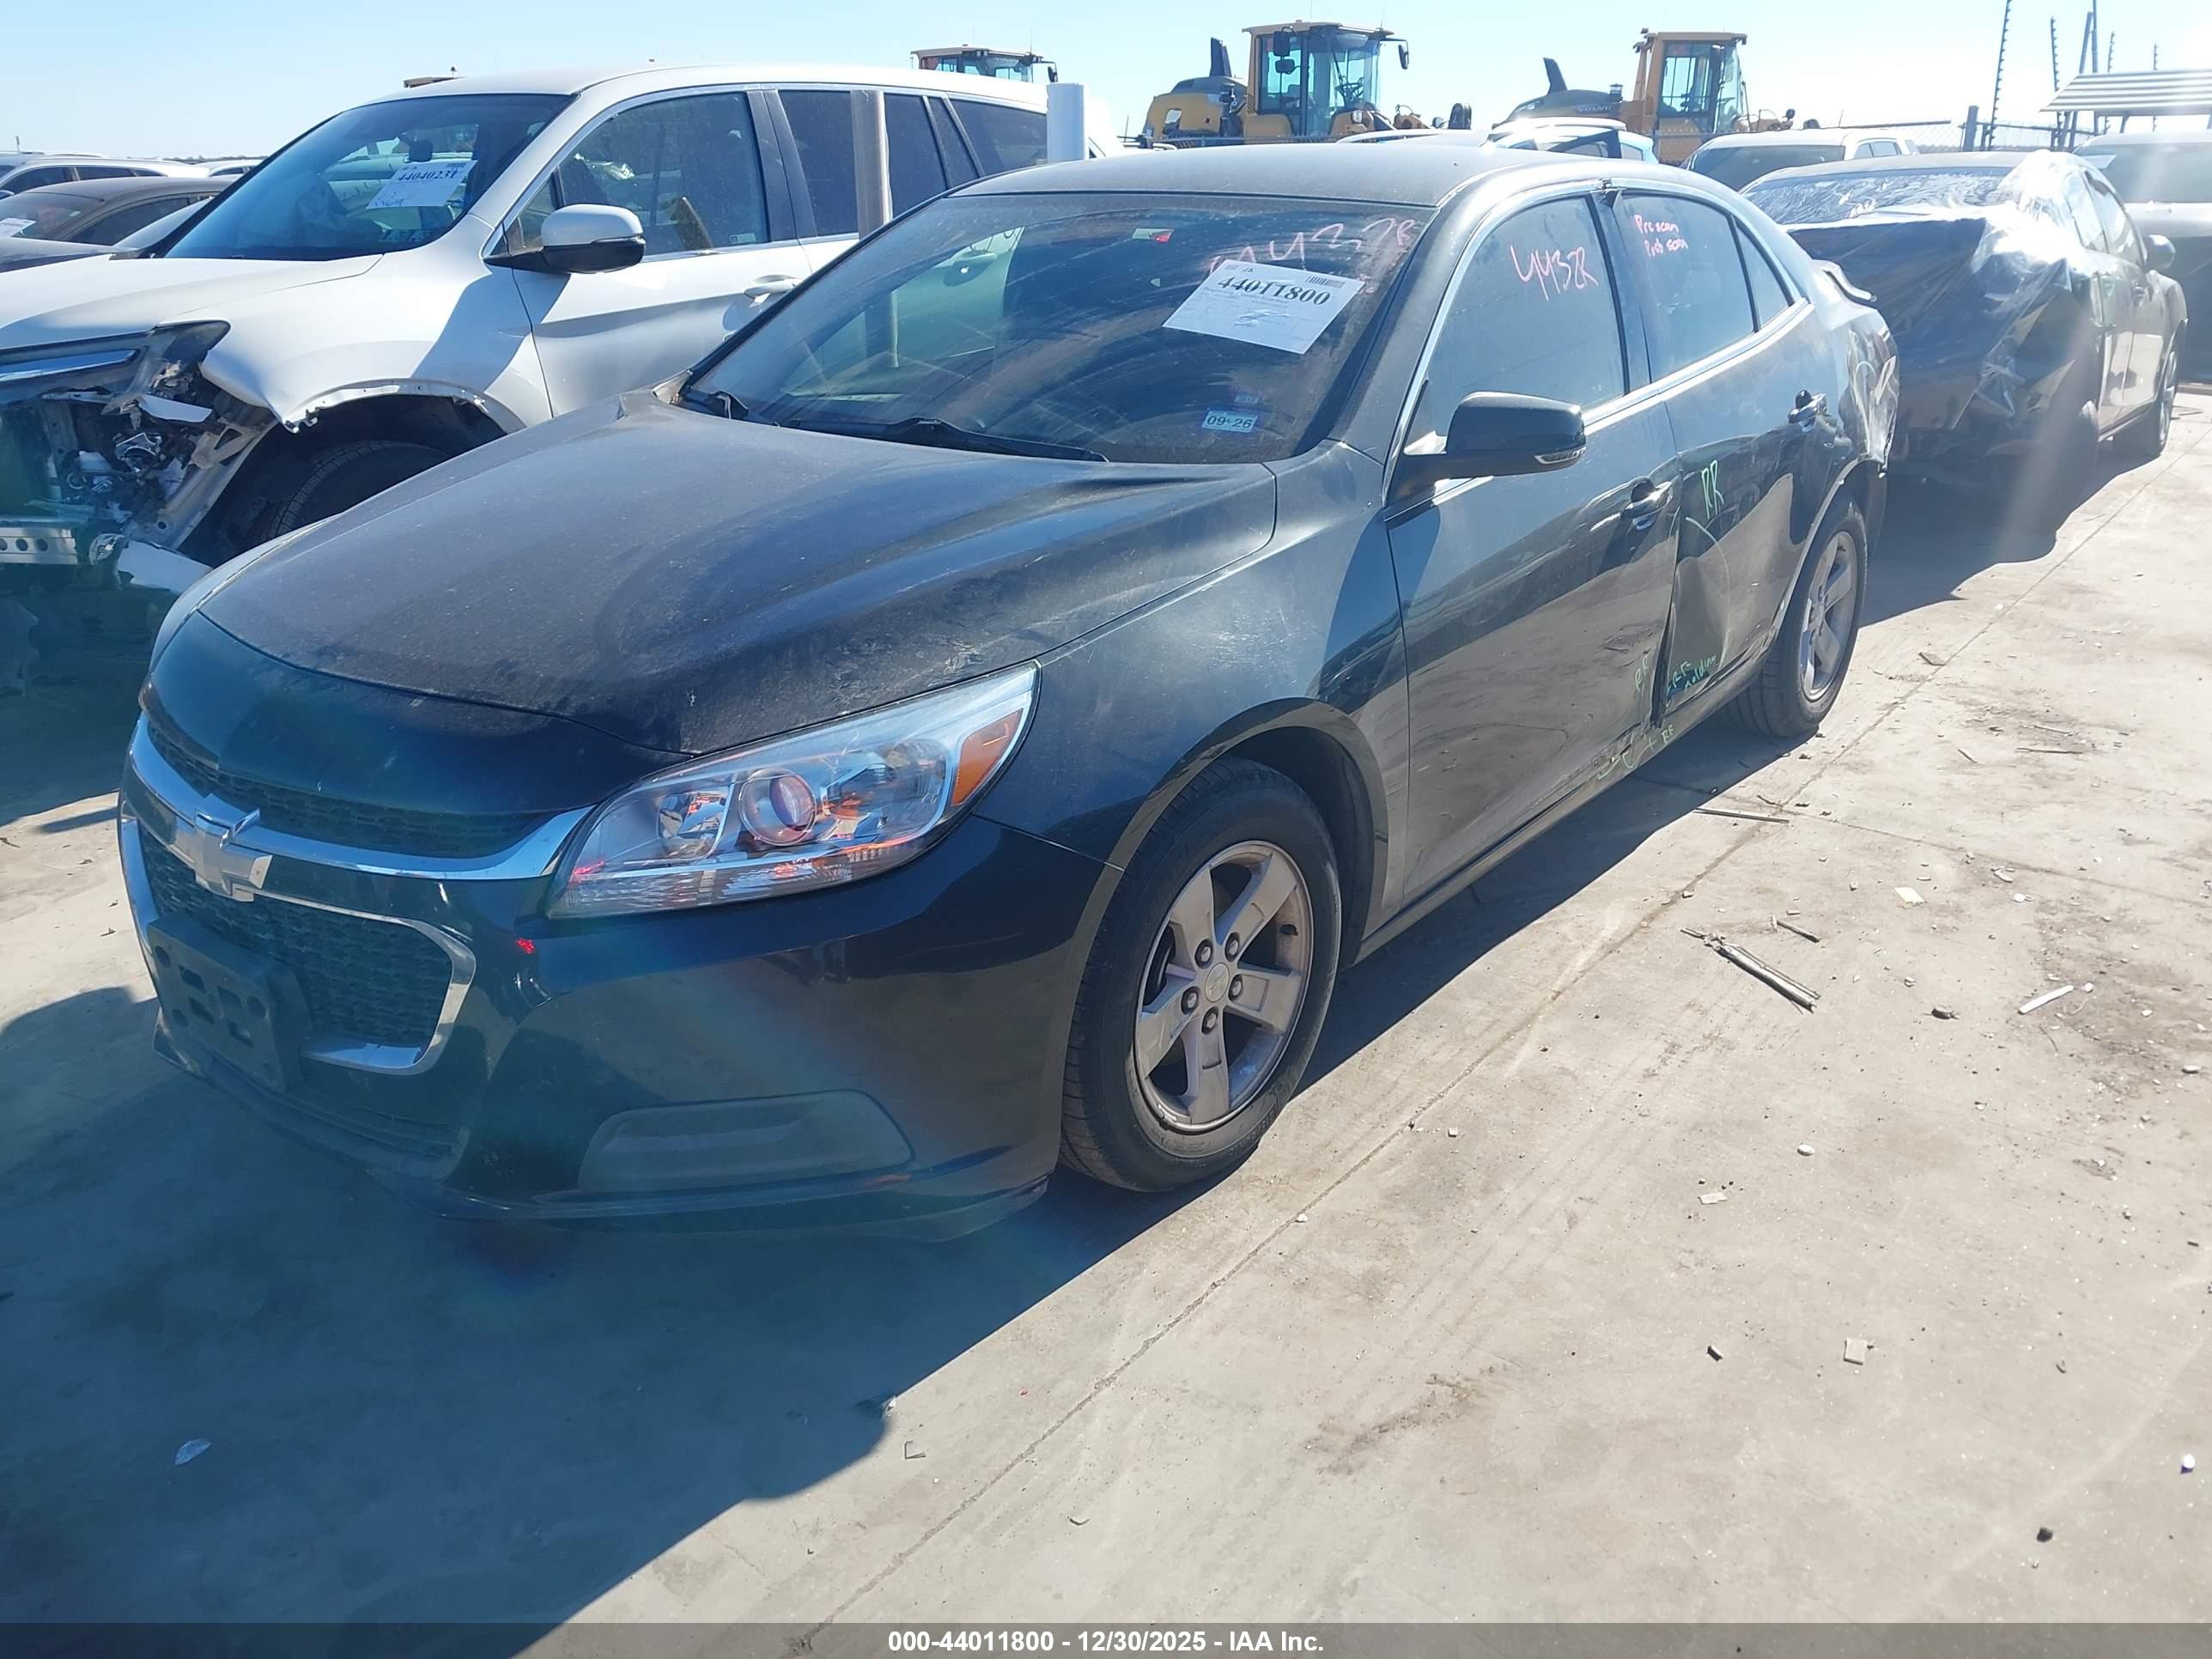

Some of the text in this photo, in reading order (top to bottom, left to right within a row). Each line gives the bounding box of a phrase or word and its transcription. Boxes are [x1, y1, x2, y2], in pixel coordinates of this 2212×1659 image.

[398, 170, 458, 180] 44040231
[1218, 276, 1331, 306] 44011800
[1701, 459, 1725, 520] RR
